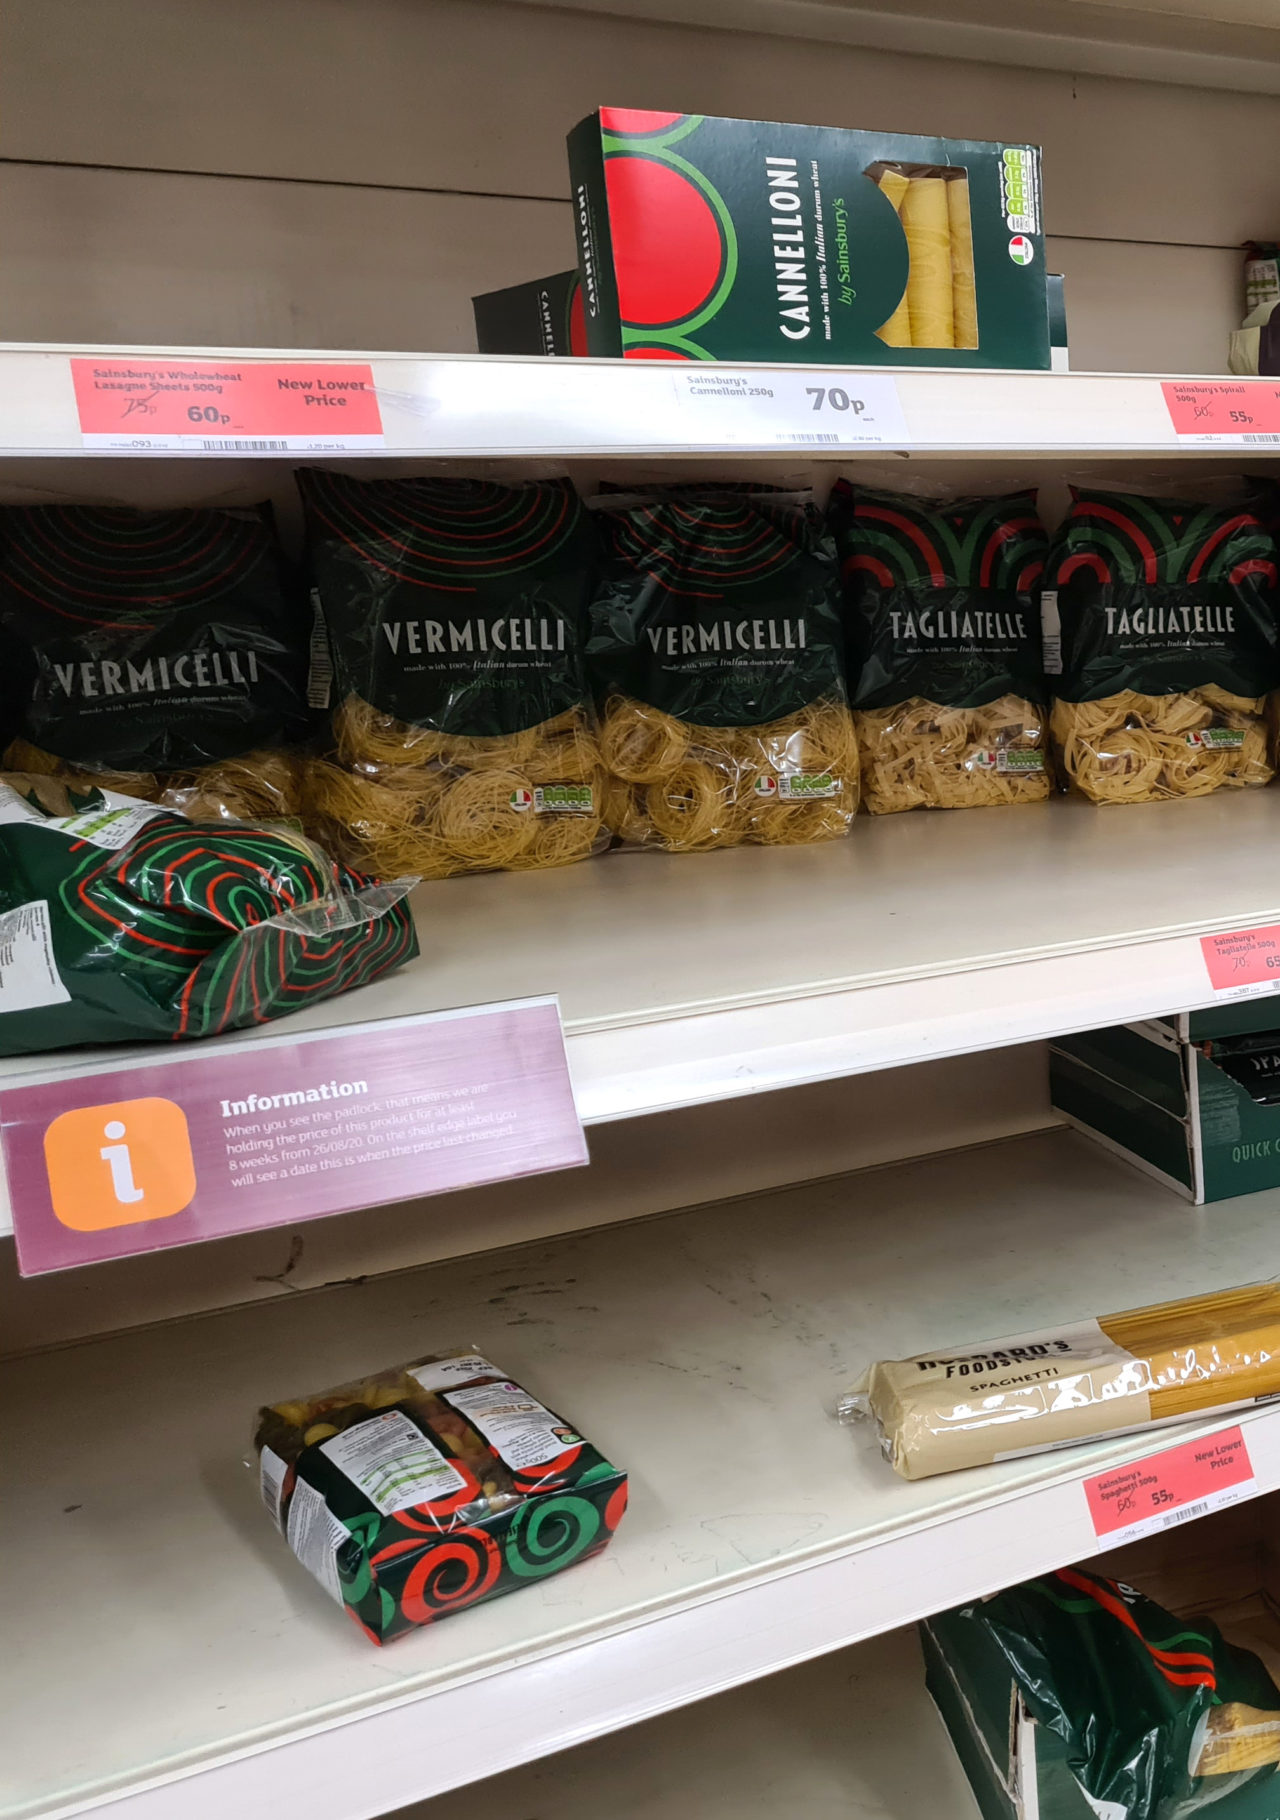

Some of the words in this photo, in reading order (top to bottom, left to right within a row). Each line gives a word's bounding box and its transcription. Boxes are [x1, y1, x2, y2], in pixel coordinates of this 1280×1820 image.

[810, 160, 820, 188] wheat
[813, 190, 823, 221] durum
[577, 185, 596, 318] CANNELLONI
[765, 157, 811, 340] CANNELLONI
[815, 223, 826, 262] Italian
[831, 197, 851, 283] Sainsbury's
[818, 264, 828, 290] 100%
[820, 293, 830, 315] with
[837, 285, 857, 306] by
[822, 316, 832, 340] made
[93, 369, 165, 382] Sainsbury's
[168, 371, 242, 382] Wholewheat
[94, 381, 146, 392] Lasagne
[149, 382, 190, 392] Sheets
[192, 382, 223, 394] 500g
[277, 378, 311, 391] New
[317, 379, 365, 391] Lower
[687, 376, 748, 386] Sainsbury's
[303, 394, 347, 407] Price
[690, 386, 746, 396] Cannelloni
[749, 388, 774, 398] 250g
[806, 388, 865, 415] 70p
[1174, 386, 1218, 395] Sainsbury's
[1176, 395, 1196, 404] 500g
[187, 406, 230, 425] 60p
[1230, 411, 1253, 425] 55p
[890, 610, 1027, 639] TAGLIATELLE
[1105, 606, 1235, 635] TAGLIATELLE
[382, 618, 565, 656] VERMICELLI
[647, 618, 807, 656] VERMICELLI
[54, 651, 259, 697] VERMICELLI
[472, 660, 505, 671] Italian
[720, 657, 748, 667] Italian
[1214, 934, 1256, 946] Sainsbury's
[1217, 943, 1256, 956] Tagliatelle
[1257, 940, 1276, 950] 500g
[220, 1079, 368, 1118] Information
[223, 1125, 261, 1138] When
[263, 1120, 286, 1134] you
[290, 1116, 310, 1125] see
[312, 1111, 332, 1123] the
[386, 1098, 409, 1109] that
[412, 1093, 450, 1105] means
[453, 1090, 469, 1098] we
[471, 1085, 488, 1095] are
[226, 1139, 273, 1155] holding
[276, 1134, 296, 1146] the
[299, 1127, 328, 1143] price
[330, 1123, 345, 1135] of
[345, 1120, 367, 1132] this
[370, 1111, 414, 1129] product
[416, 1108, 432, 1120] for
[434, 1106, 446, 1117] at
[448, 1101, 475, 1115] least
[229, 1160, 237, 1171] 8
[239, 1154, 279, 1169] weeks
[282, 1147, 310, 1161] from
[367, 1133, 385, 1145] On
[386, 1130, 405, 1142] the
[407, 1123, 435, 1138] shelf
[437, 1119, 465, 1135] edge
[467, 1113, 494, 1128] label
[495, 1110, 517, 1124] you
[231, 1174, 254, 1188] will
[257, 1171, 277, 1183] see
[280, 1169, 288, 1179] a
[290, 1163, 318, 1177] date
[320, 1158, 343, 1172] this
[345, 1156, 355, 1167] is
[357, 1150, 390, 1164] when
[391, 1146, 411, 1158] the
[413, 1139, 441, 1155] price
[442, 1135, 463, 1148] last
[1232, 1143, 1271, 1163] QUICK
[916, 1340, 1070, 1371] ARD'S
[946, 1353, 1057, 1378] FOODS
[970, 1368, 1059, 1392] SPAGHETTI
[1194, 1449, 1214, 1462] New
[1215, 1440, 1242, 1456] Lower
[1210, 1456, 1234, 1470] Price
[1098, 1471, 1142, 1491] Sainsbury's
[1101, 1482, 1138, 1501] Spaghetti
[1139, 1475, 1158, 1487] 500g
[1152, 1489, 1174, 1506] 55p
